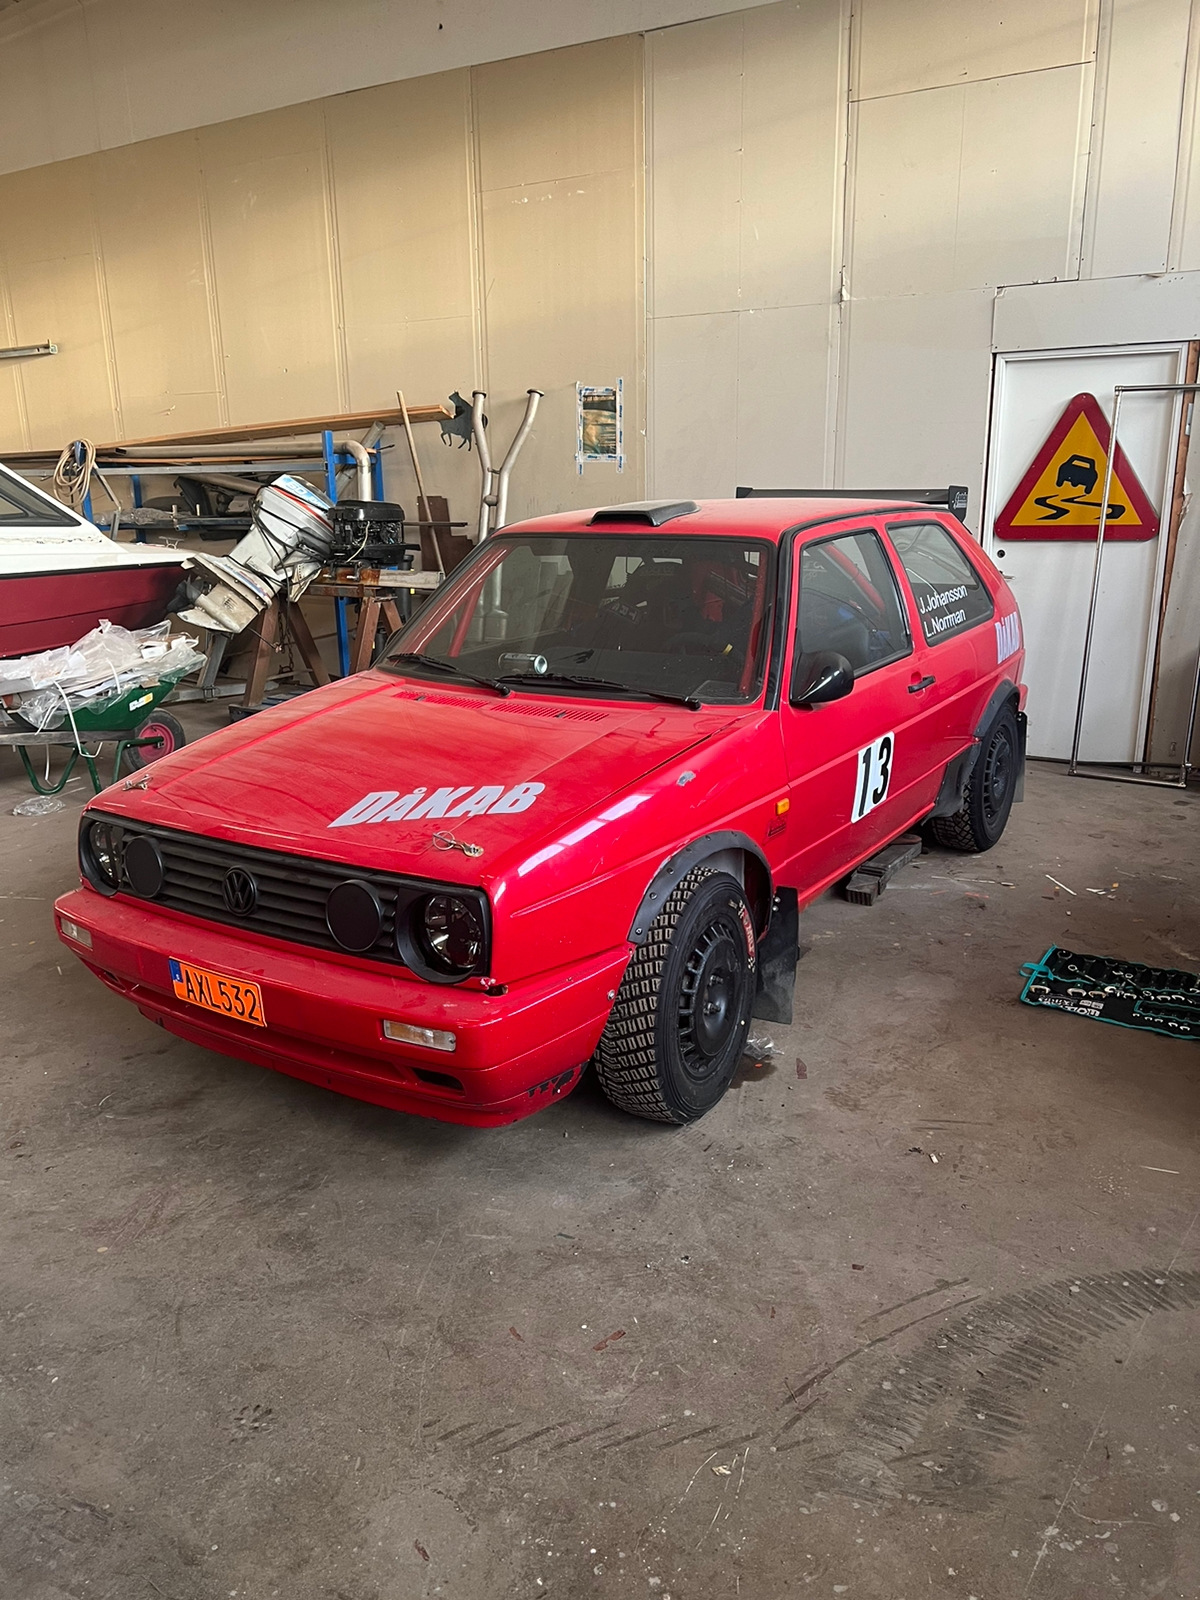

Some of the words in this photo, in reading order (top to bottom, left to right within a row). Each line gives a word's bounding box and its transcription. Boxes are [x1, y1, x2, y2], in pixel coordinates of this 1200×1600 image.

[920, 585, 968, 614] J.Johansson
[858, 736, 892, 817] 13
[327, 782, 545, 828] DÅKAB
